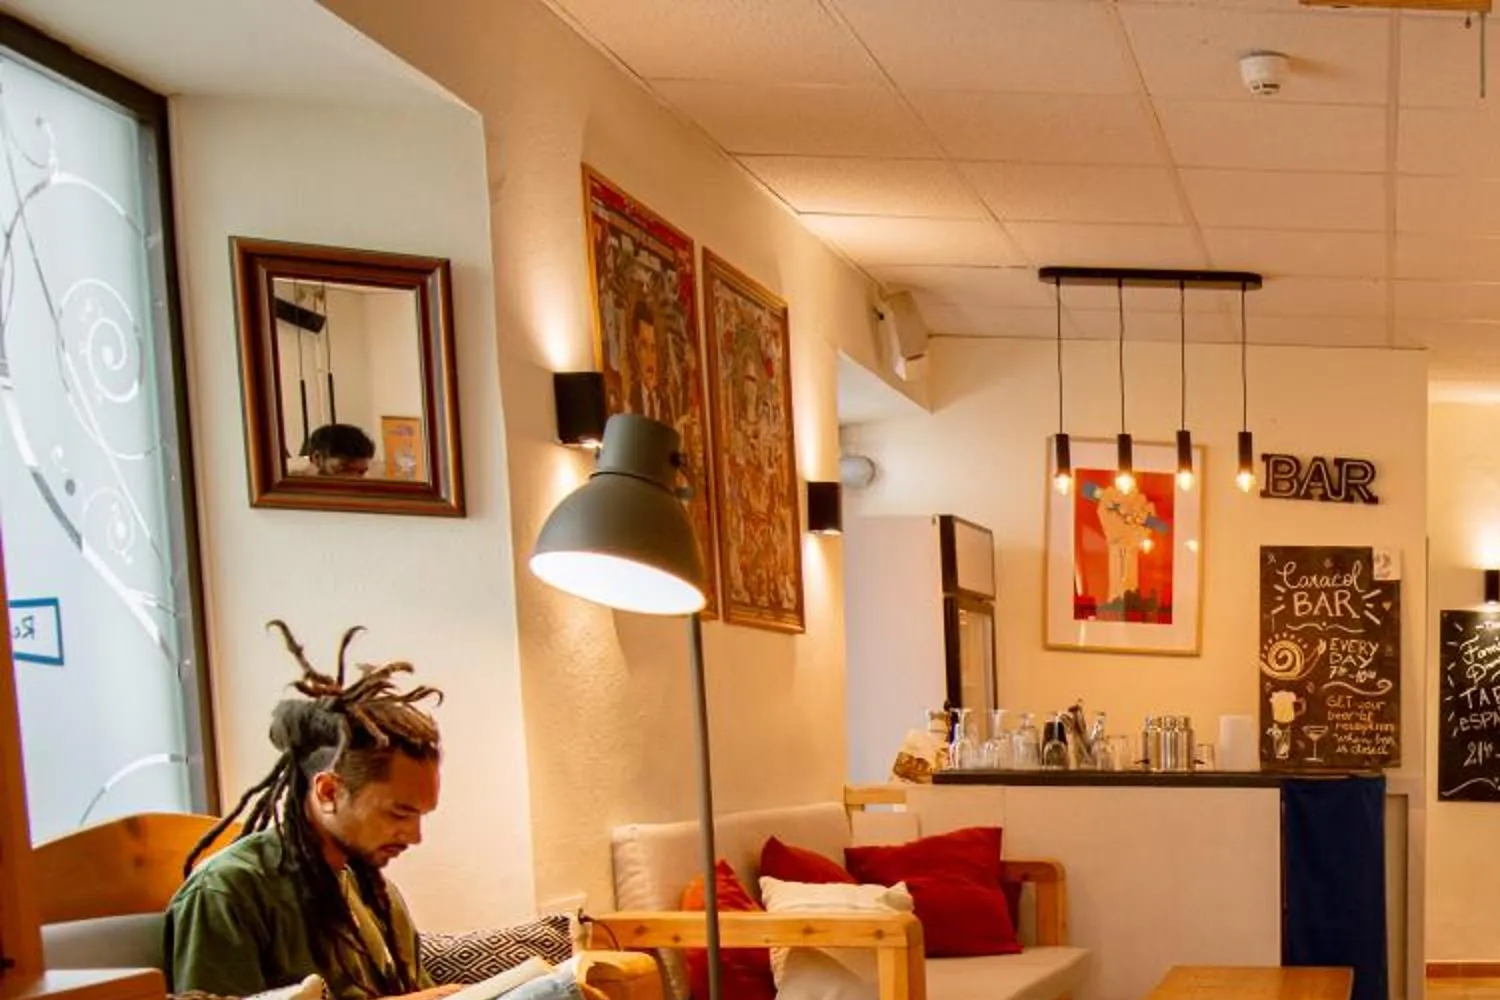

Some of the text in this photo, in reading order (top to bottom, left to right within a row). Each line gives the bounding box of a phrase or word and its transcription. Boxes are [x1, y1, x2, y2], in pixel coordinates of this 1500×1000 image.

[1260, 454, 1378, 504] BAR
[1276, 561, 1365, 592] Caracol
[1293, 589, 1360, 618] BAR
[1329, 637, 1379, 656] EVERY
[1329, 652, 1373, 669] DAY
